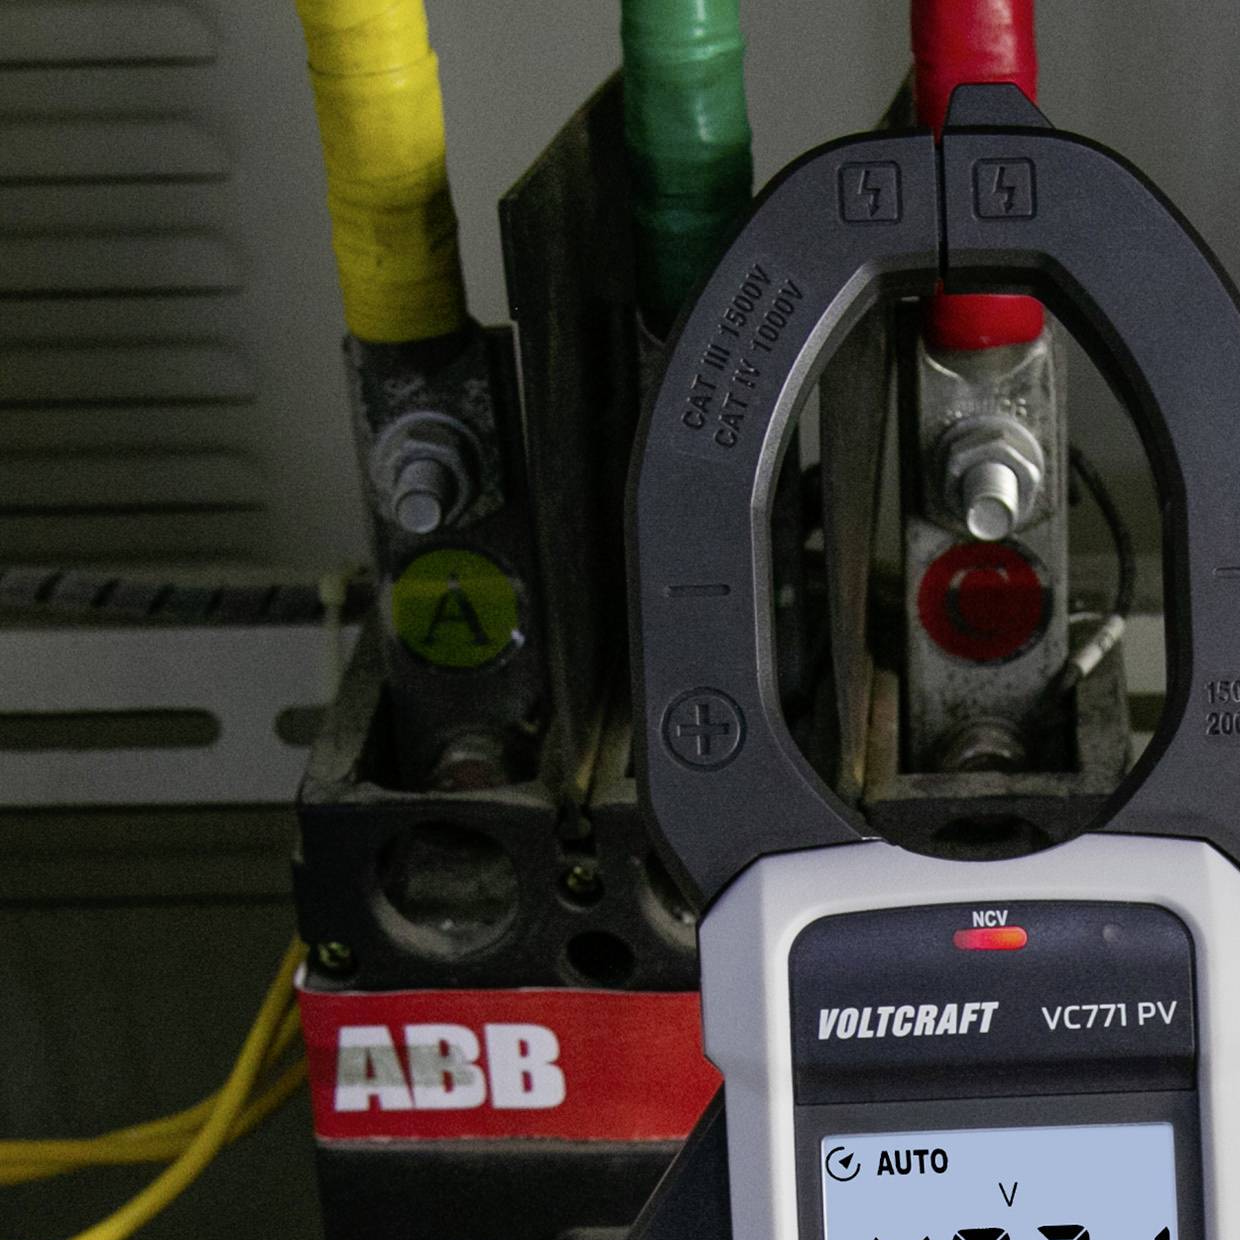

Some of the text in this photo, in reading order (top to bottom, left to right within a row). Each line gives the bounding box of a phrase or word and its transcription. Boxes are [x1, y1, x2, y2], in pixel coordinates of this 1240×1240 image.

[682, 374, 716, 430] CAT
[719, 264, 770, 338] 1500V
[714, 392, 748, 448] CAT
[751, 279, 803, 352] 1000V
[418, 571, 496, 645] A
[973, 910, 1008, 927] NCV
[819, 1002, 999, 1039] VOLTCRAFT
[1042, 1001, 1176, 1030] VC771 PV
[334, 1023, 567, 1112] ABB
[877, 1149, 948, 1175] AUTO
[999, 1182, 1018, 1207] V
